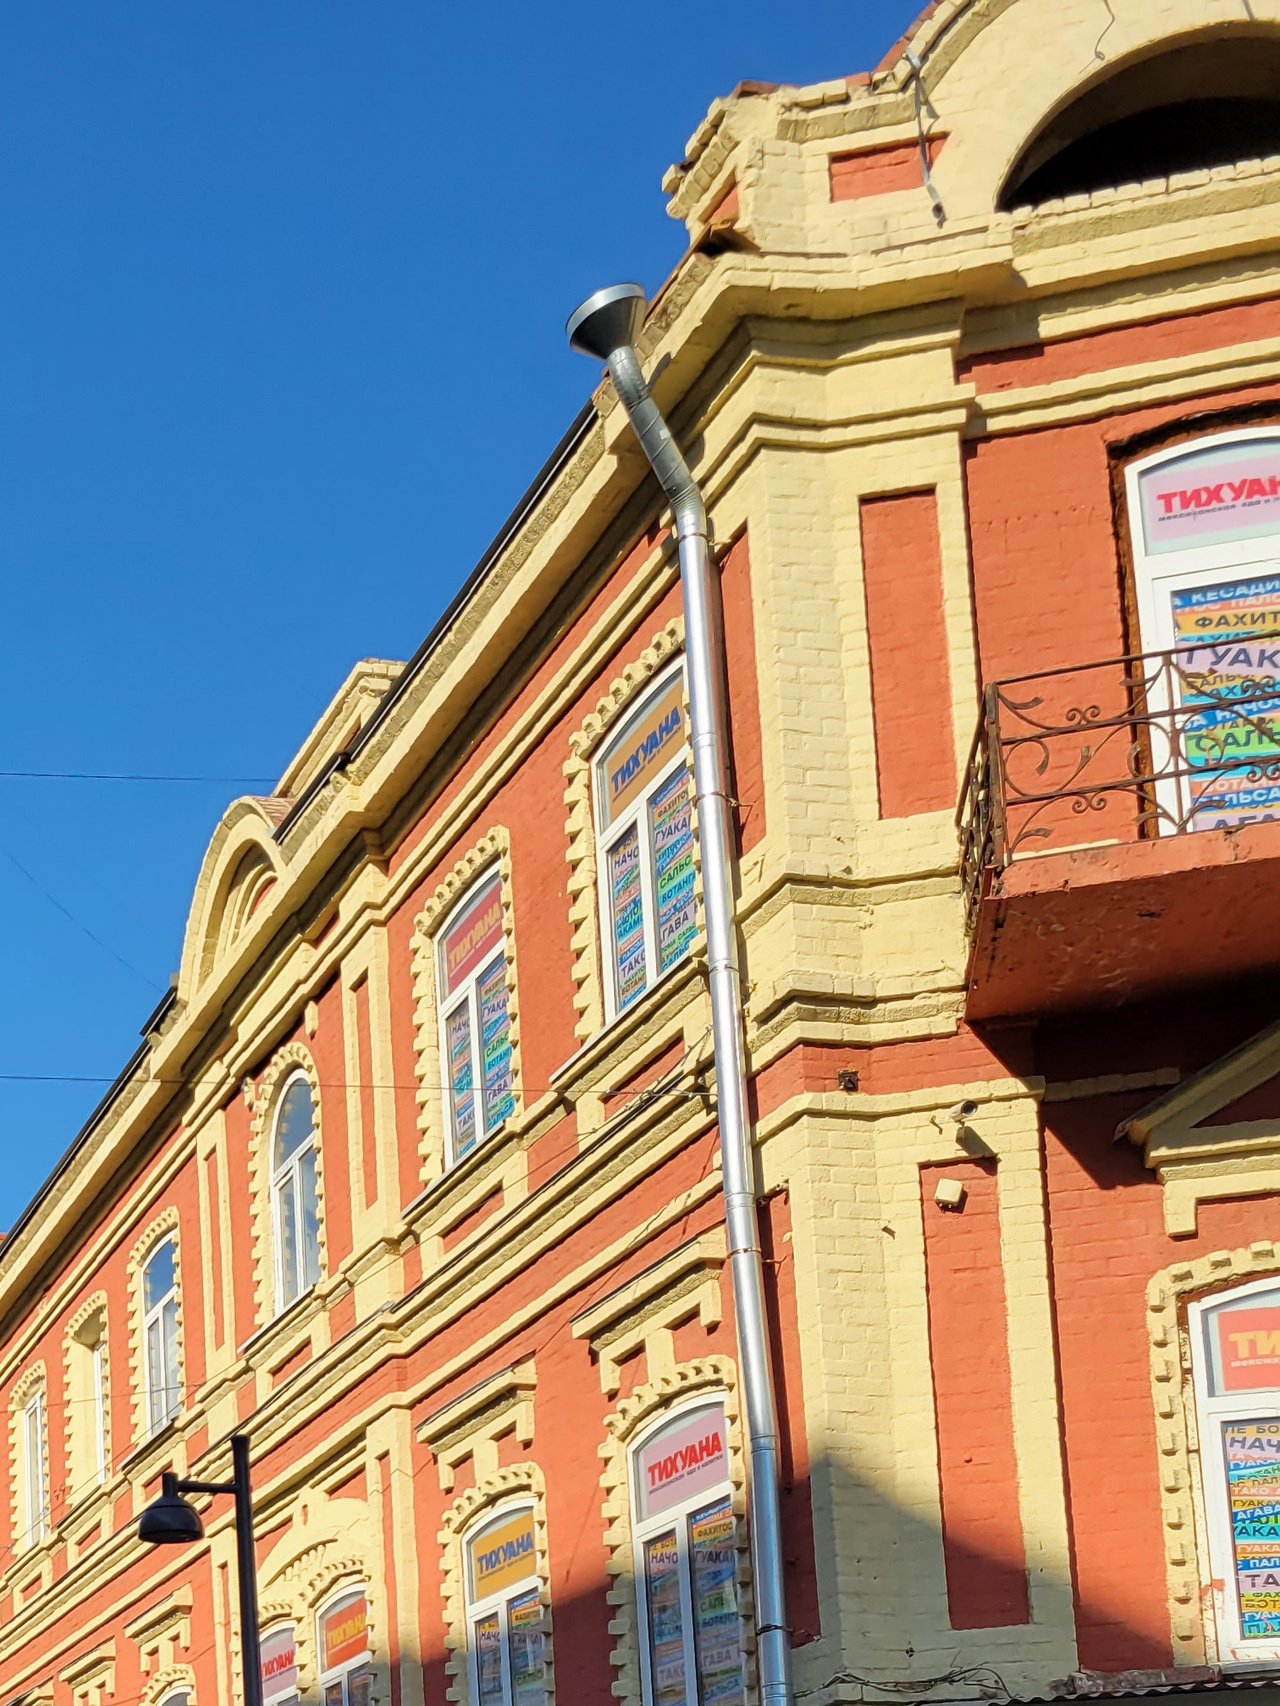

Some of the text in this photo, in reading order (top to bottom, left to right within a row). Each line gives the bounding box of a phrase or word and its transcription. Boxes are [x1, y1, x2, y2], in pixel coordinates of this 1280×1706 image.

[611, 706, 680, 793] ТИХУАНА
[449, 901, 500, 971] ТИХУАНА
[660, 911, 689, 943] ГАВА
[648, 1432, 723, 1487] ТИХУАНА
[477, 1532, 534, 1574] ТИХУАНА
